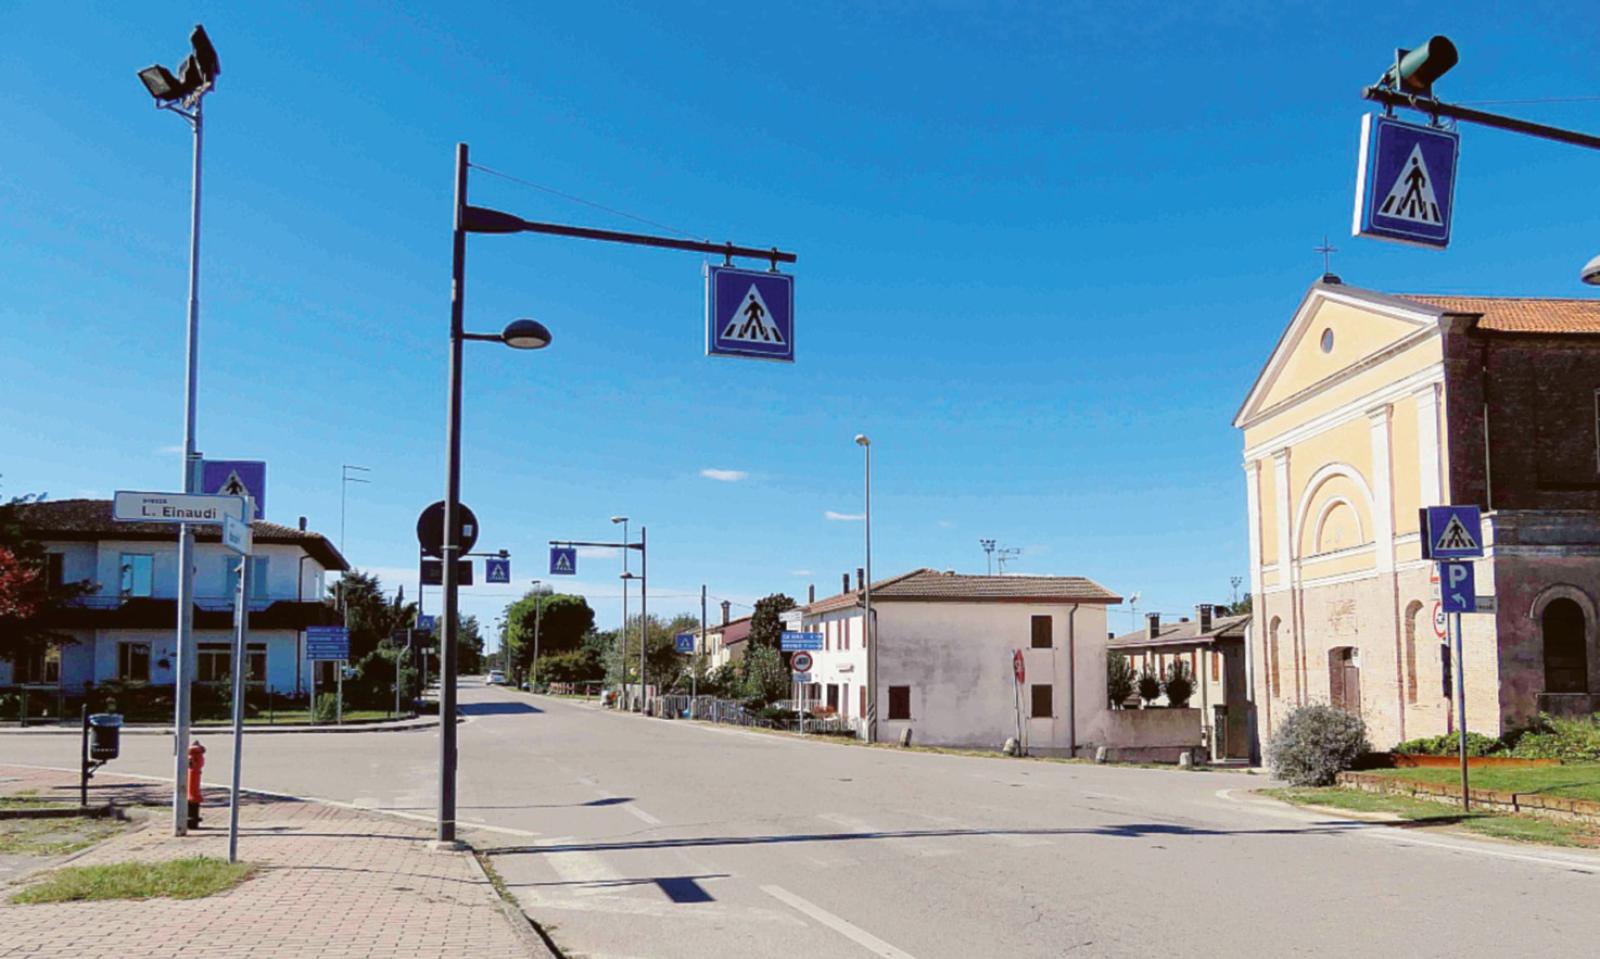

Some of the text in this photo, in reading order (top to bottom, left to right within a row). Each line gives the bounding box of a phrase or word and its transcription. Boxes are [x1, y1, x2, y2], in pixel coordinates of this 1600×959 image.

[142, 505, 217, 519] L. Einaudi
[1449, 564, 1468, 589] P
